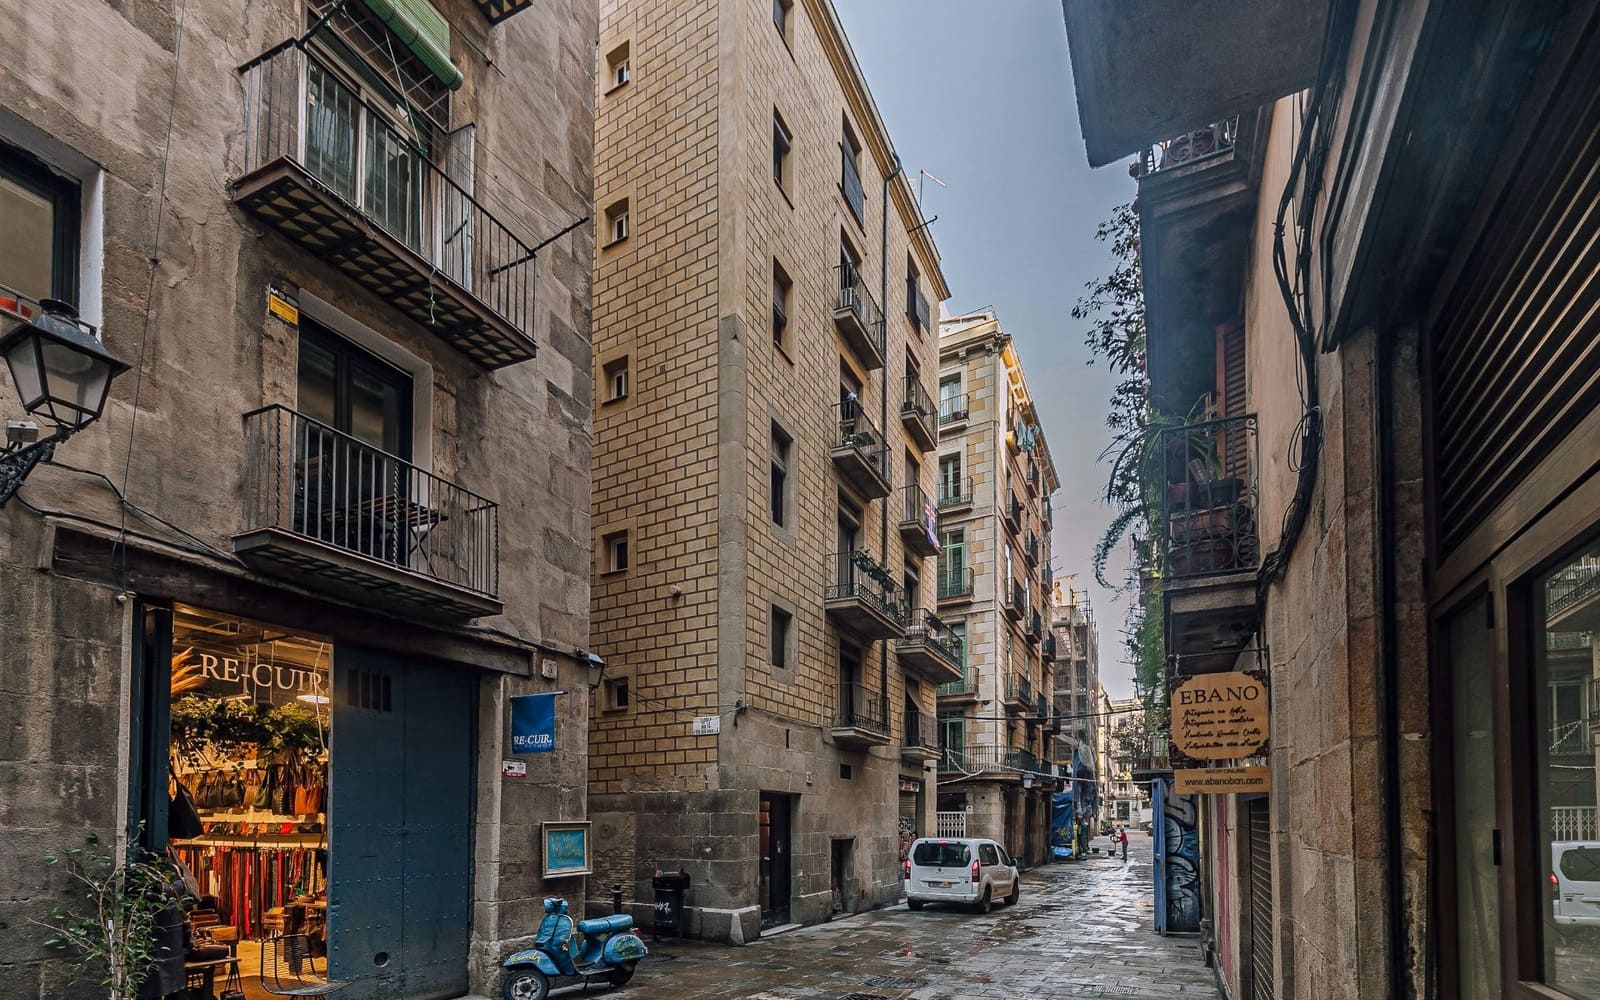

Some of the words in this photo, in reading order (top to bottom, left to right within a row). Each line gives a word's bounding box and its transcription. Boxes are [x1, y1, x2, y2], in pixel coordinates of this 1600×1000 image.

[200, 653, 325, 694] RE-CUIR
[1180, 686, 1259, 705] EBANO
[1184, 777, 1263, 785] www.ebanobcn.com
